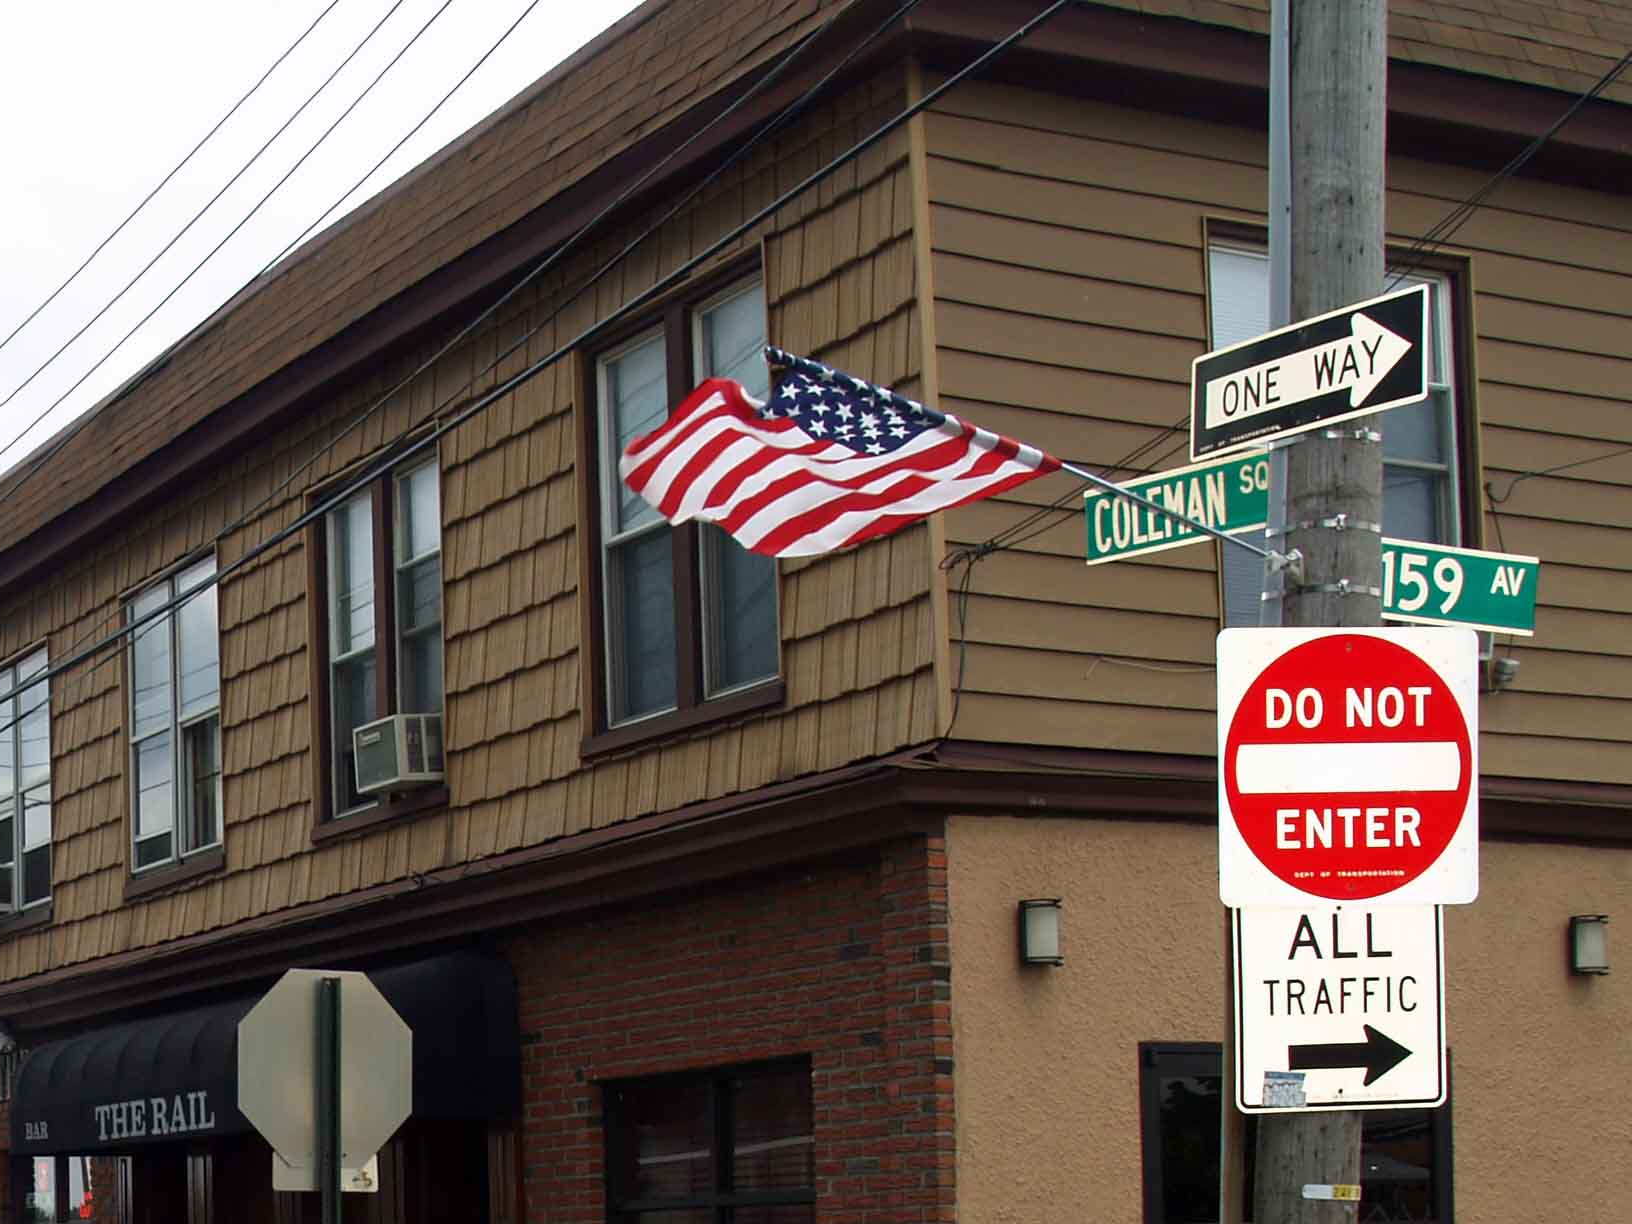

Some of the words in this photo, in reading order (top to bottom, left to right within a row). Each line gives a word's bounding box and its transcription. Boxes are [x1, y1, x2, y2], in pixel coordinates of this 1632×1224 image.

[1222, 365, 1282, 418] ONE
[1313, 334, 1384, 390] WAY
[1094, 471, 1227, 554] COLEMAN
[1239, 460, 1269, 495] SQ
[1381, 551, 1464, 615] 159
[1489, 565, 1526, 597] AV
[1264, 687, 1323, 729] DO
[1345, 686, 1433, 728] NOT
[1275, 807, 1422, 850] ENTER
[1287, 912, 1393, 961] ALL
[1262, 975, 1418, 1017] TRAFFIC
[24, 1120, 49, 1140] BAR
[95, 1100, 146, 1142] THE
[150, 1090, 216, 1135] RAIL
